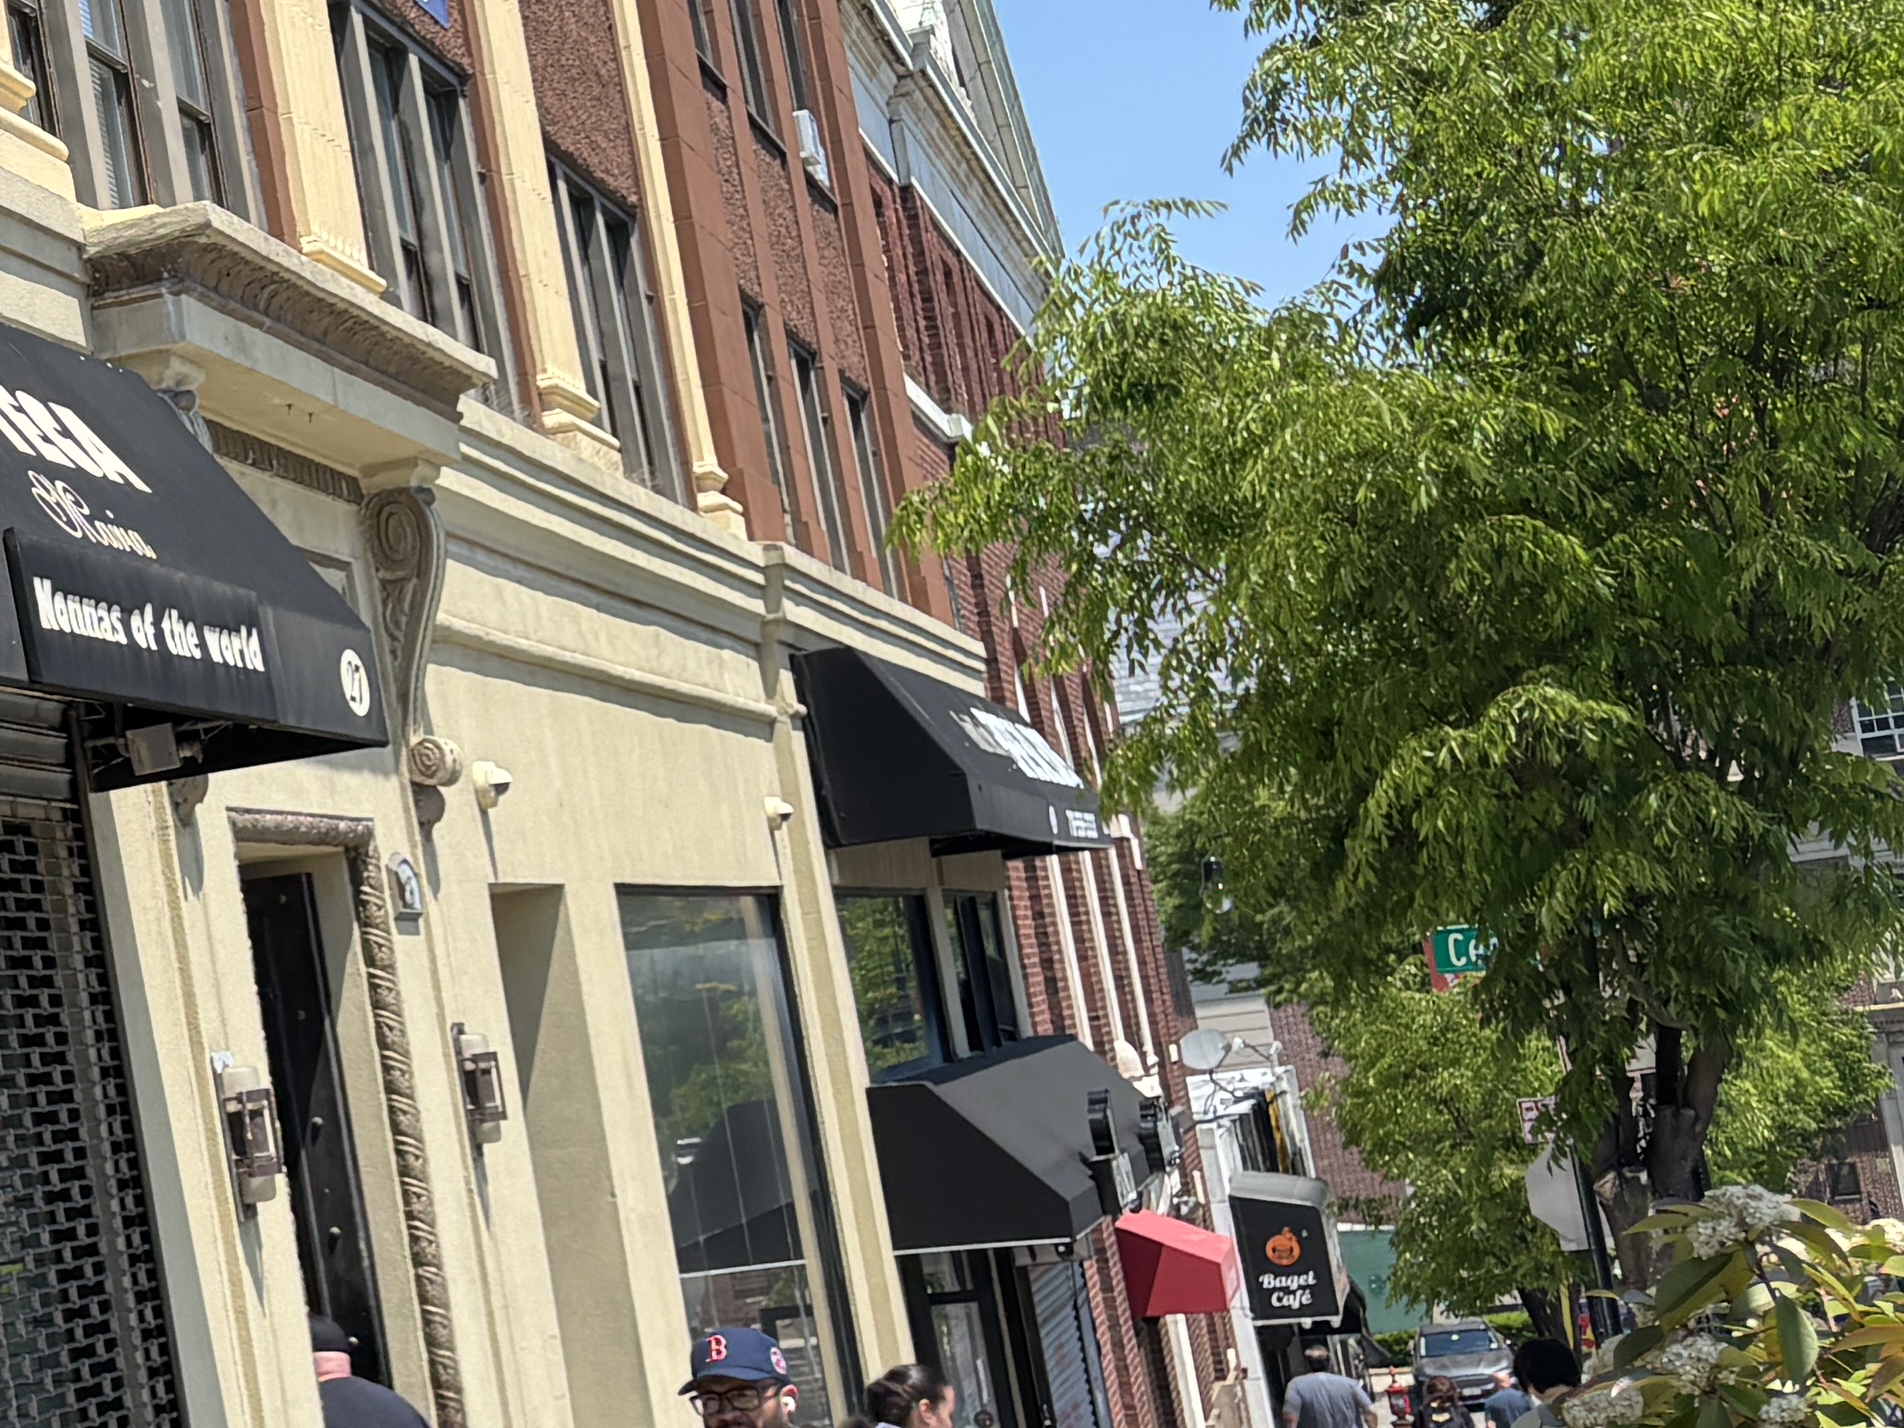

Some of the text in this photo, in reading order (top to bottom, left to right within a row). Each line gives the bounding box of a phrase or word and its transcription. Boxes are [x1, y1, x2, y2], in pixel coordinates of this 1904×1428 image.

[33, 577, 265, 673] Nonnas of the world
[1259, 1270, 1317, 1290] Bagel
[1271, 1289, 1312, 1310] Café
[706, 1334, 727, 1362] B
